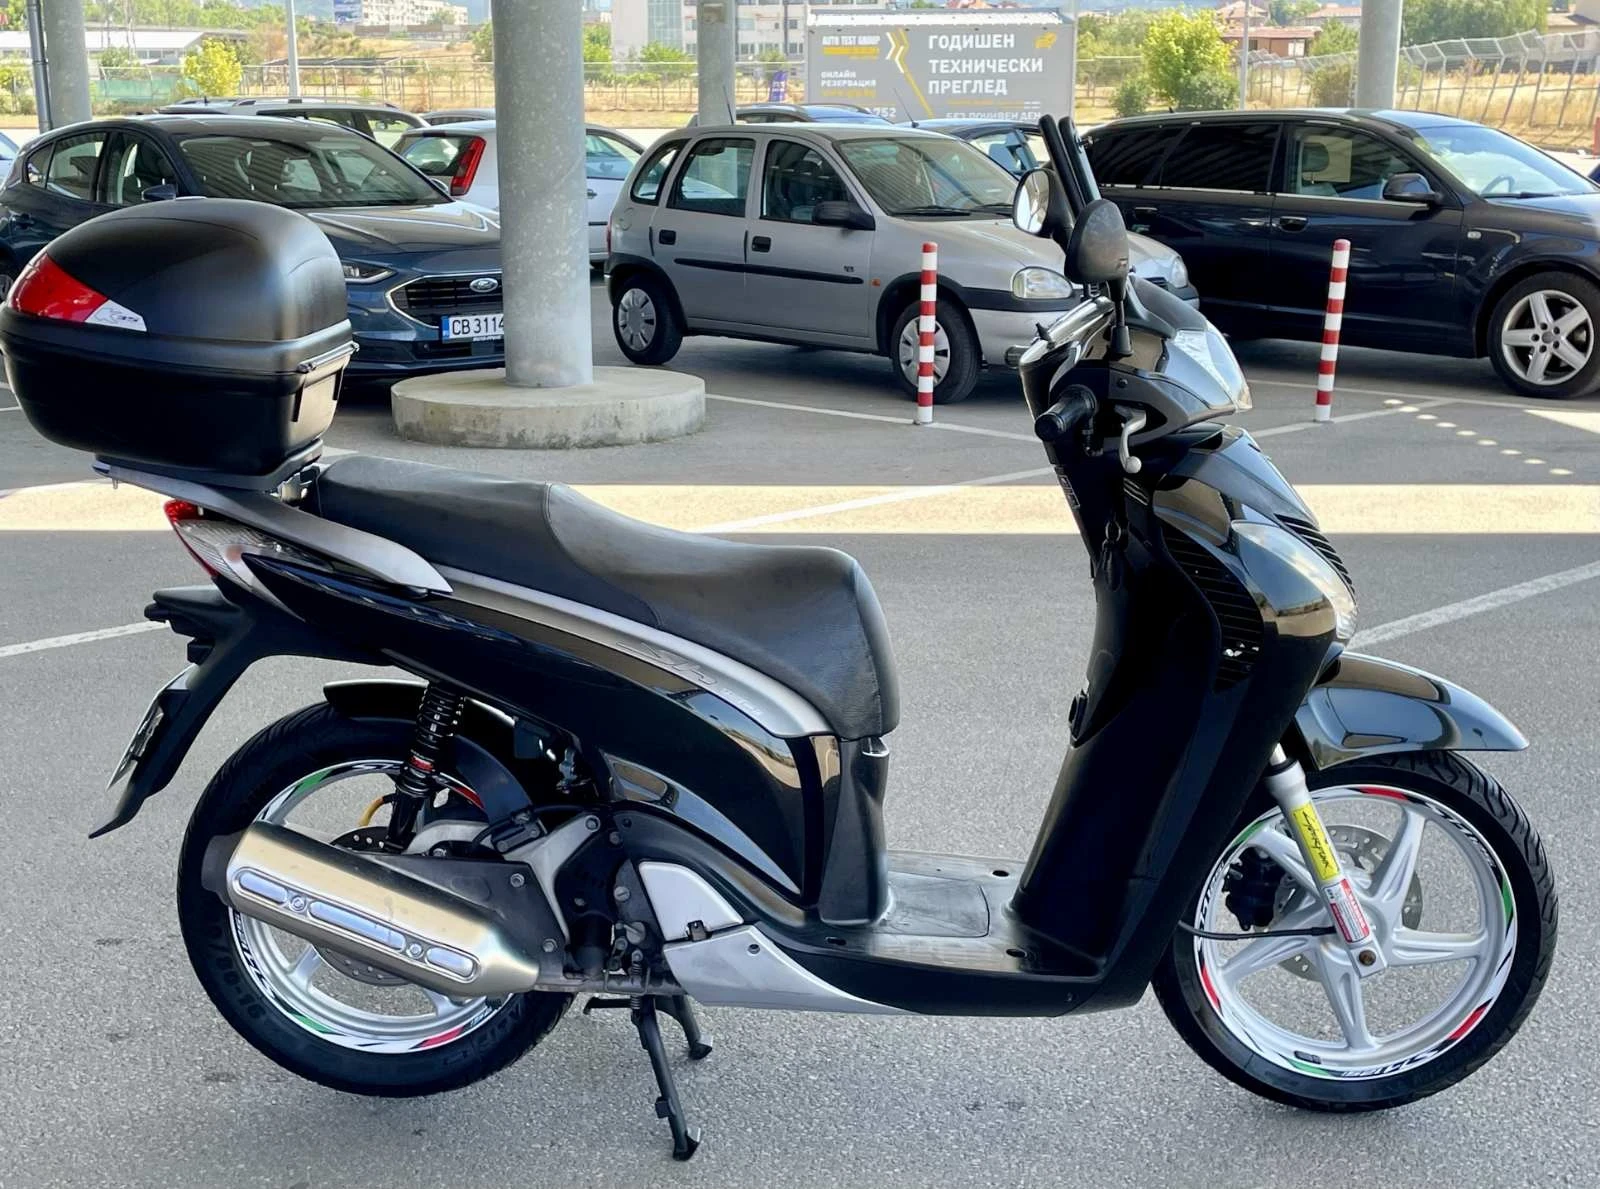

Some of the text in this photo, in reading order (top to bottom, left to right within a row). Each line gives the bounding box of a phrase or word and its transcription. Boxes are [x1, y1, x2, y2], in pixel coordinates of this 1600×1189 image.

[928, 33, 1015, 52] ГОДИШЕН
[928, 58, 1043, 74] ТЕХНИЧЕСКИ
[928, 79, 1007, 96] ПРЕГЛЕД
